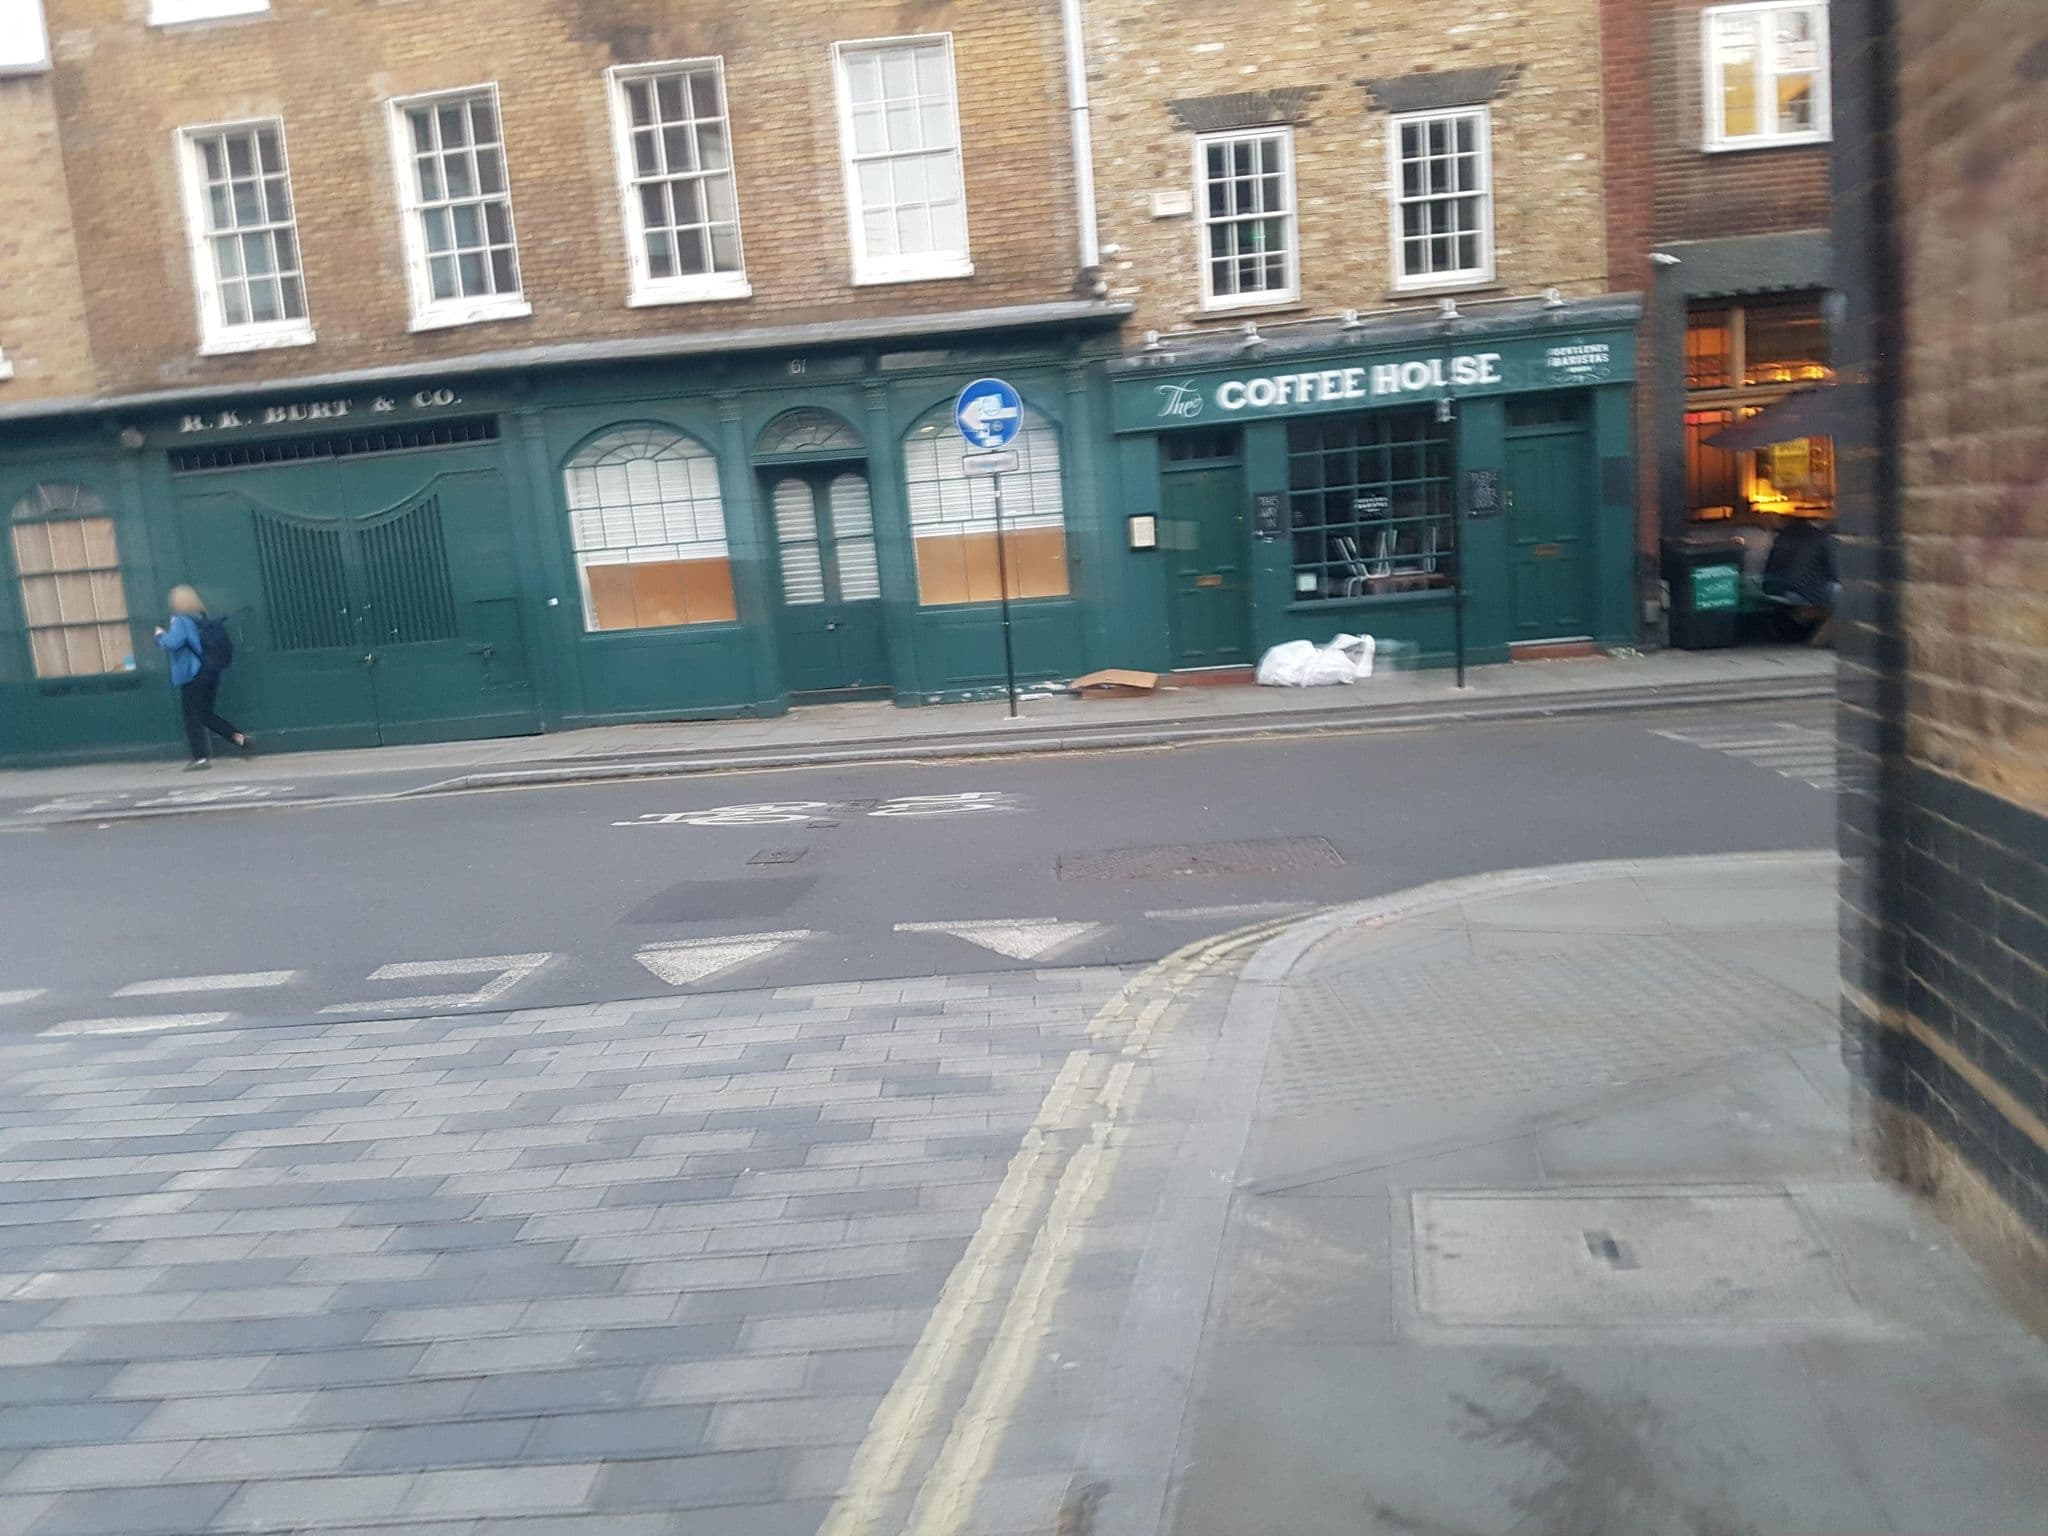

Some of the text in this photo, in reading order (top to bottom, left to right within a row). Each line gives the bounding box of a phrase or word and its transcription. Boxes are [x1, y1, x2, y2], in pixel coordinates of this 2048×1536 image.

[1547, 353, 1610, 367] BARISTAS
[264, 398, 352, 424] BURT
[373, 396, 396, 413] &
[415, 389, 462, 408] CO.
[1155, 379, 1203, 417] The
[1216, 367, 1366, 410] COFFEE
